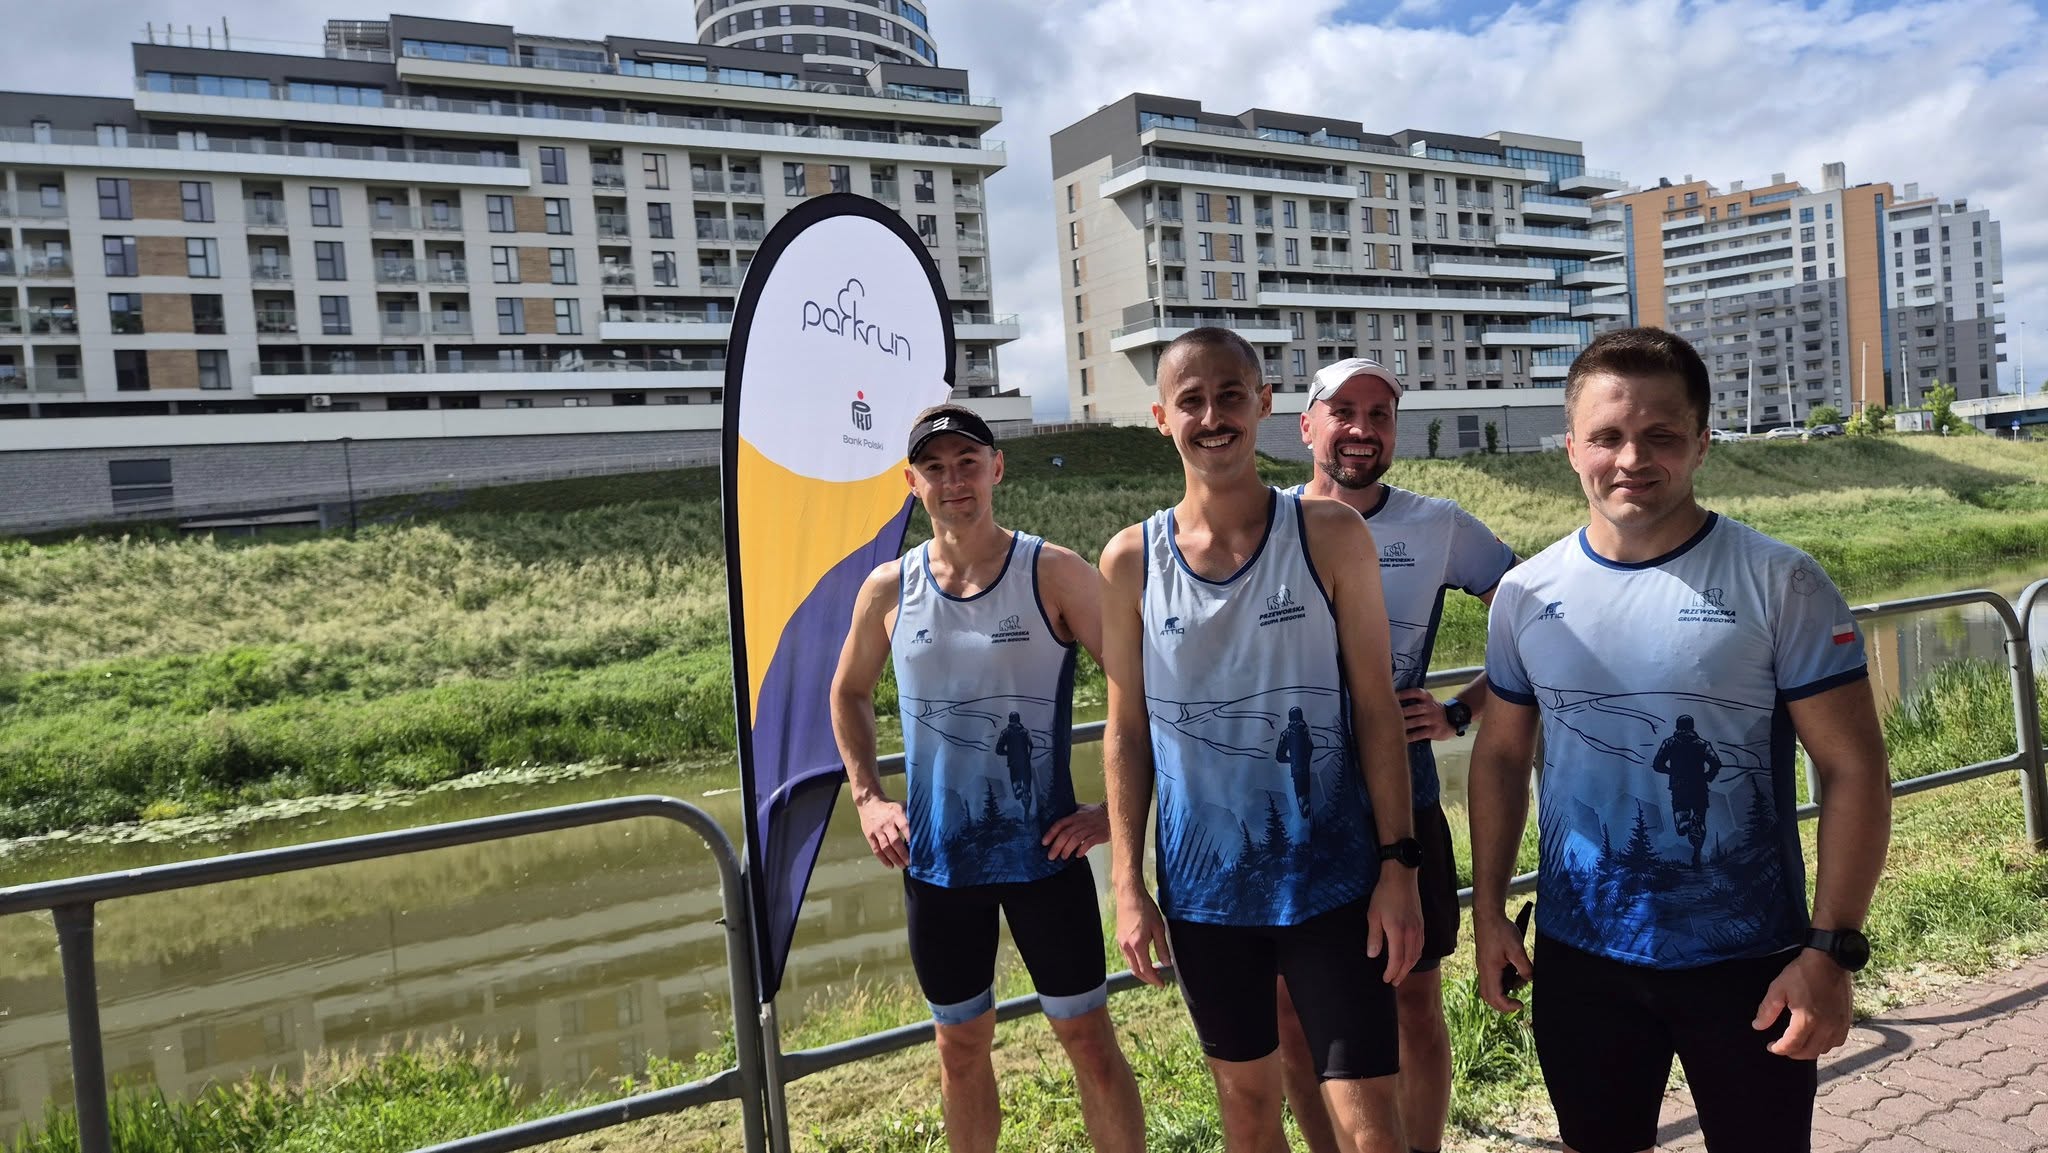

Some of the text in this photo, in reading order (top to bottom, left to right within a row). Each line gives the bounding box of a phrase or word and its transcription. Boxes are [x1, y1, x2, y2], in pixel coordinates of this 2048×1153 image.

[802, 290, 911, 361] parkrun
[852, 400, 872, 431] PKO
[843, 435, 883, 451] Bank Polski
[1259, 605, 1304, 620] PRZEWORSKA
[1679, 608, 1736, 617] PRZEWORSKA
[1260, 618, 1278, 626] GRUPA
